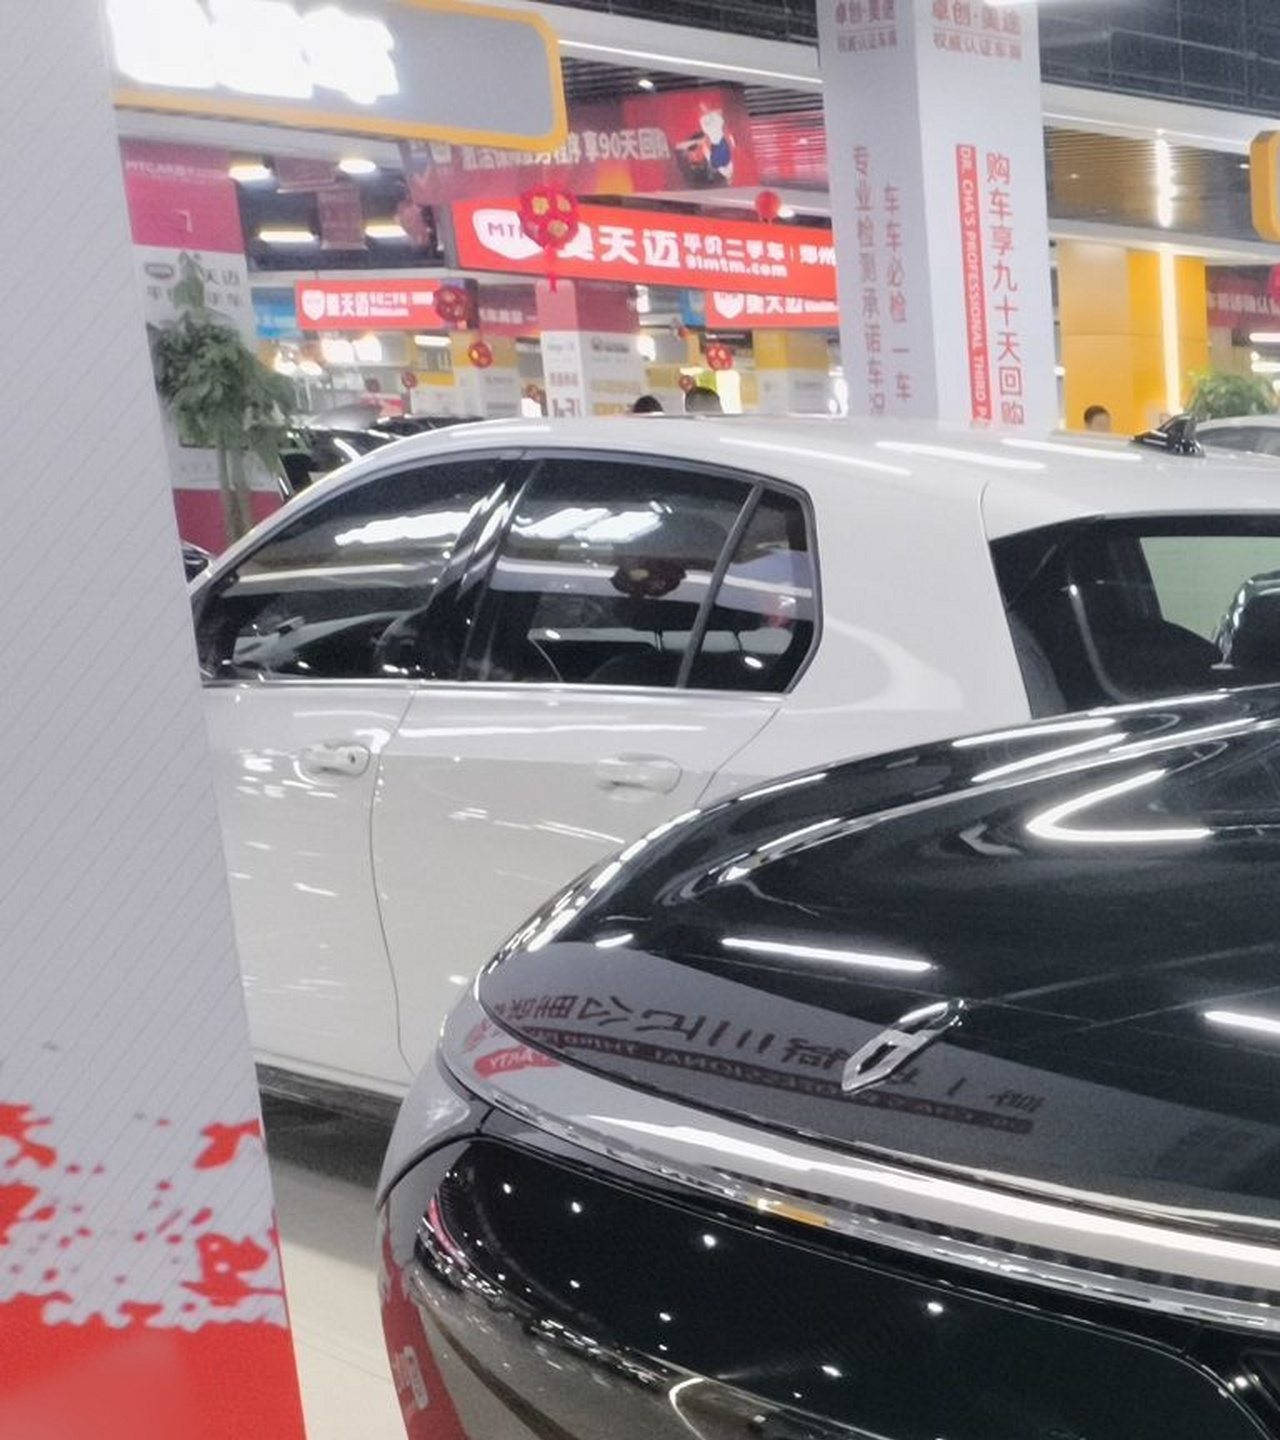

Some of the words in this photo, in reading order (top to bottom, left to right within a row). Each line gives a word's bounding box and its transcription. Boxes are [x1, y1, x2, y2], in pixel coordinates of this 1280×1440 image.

[985, 151, 1025, 426] 购车享九十天回购
